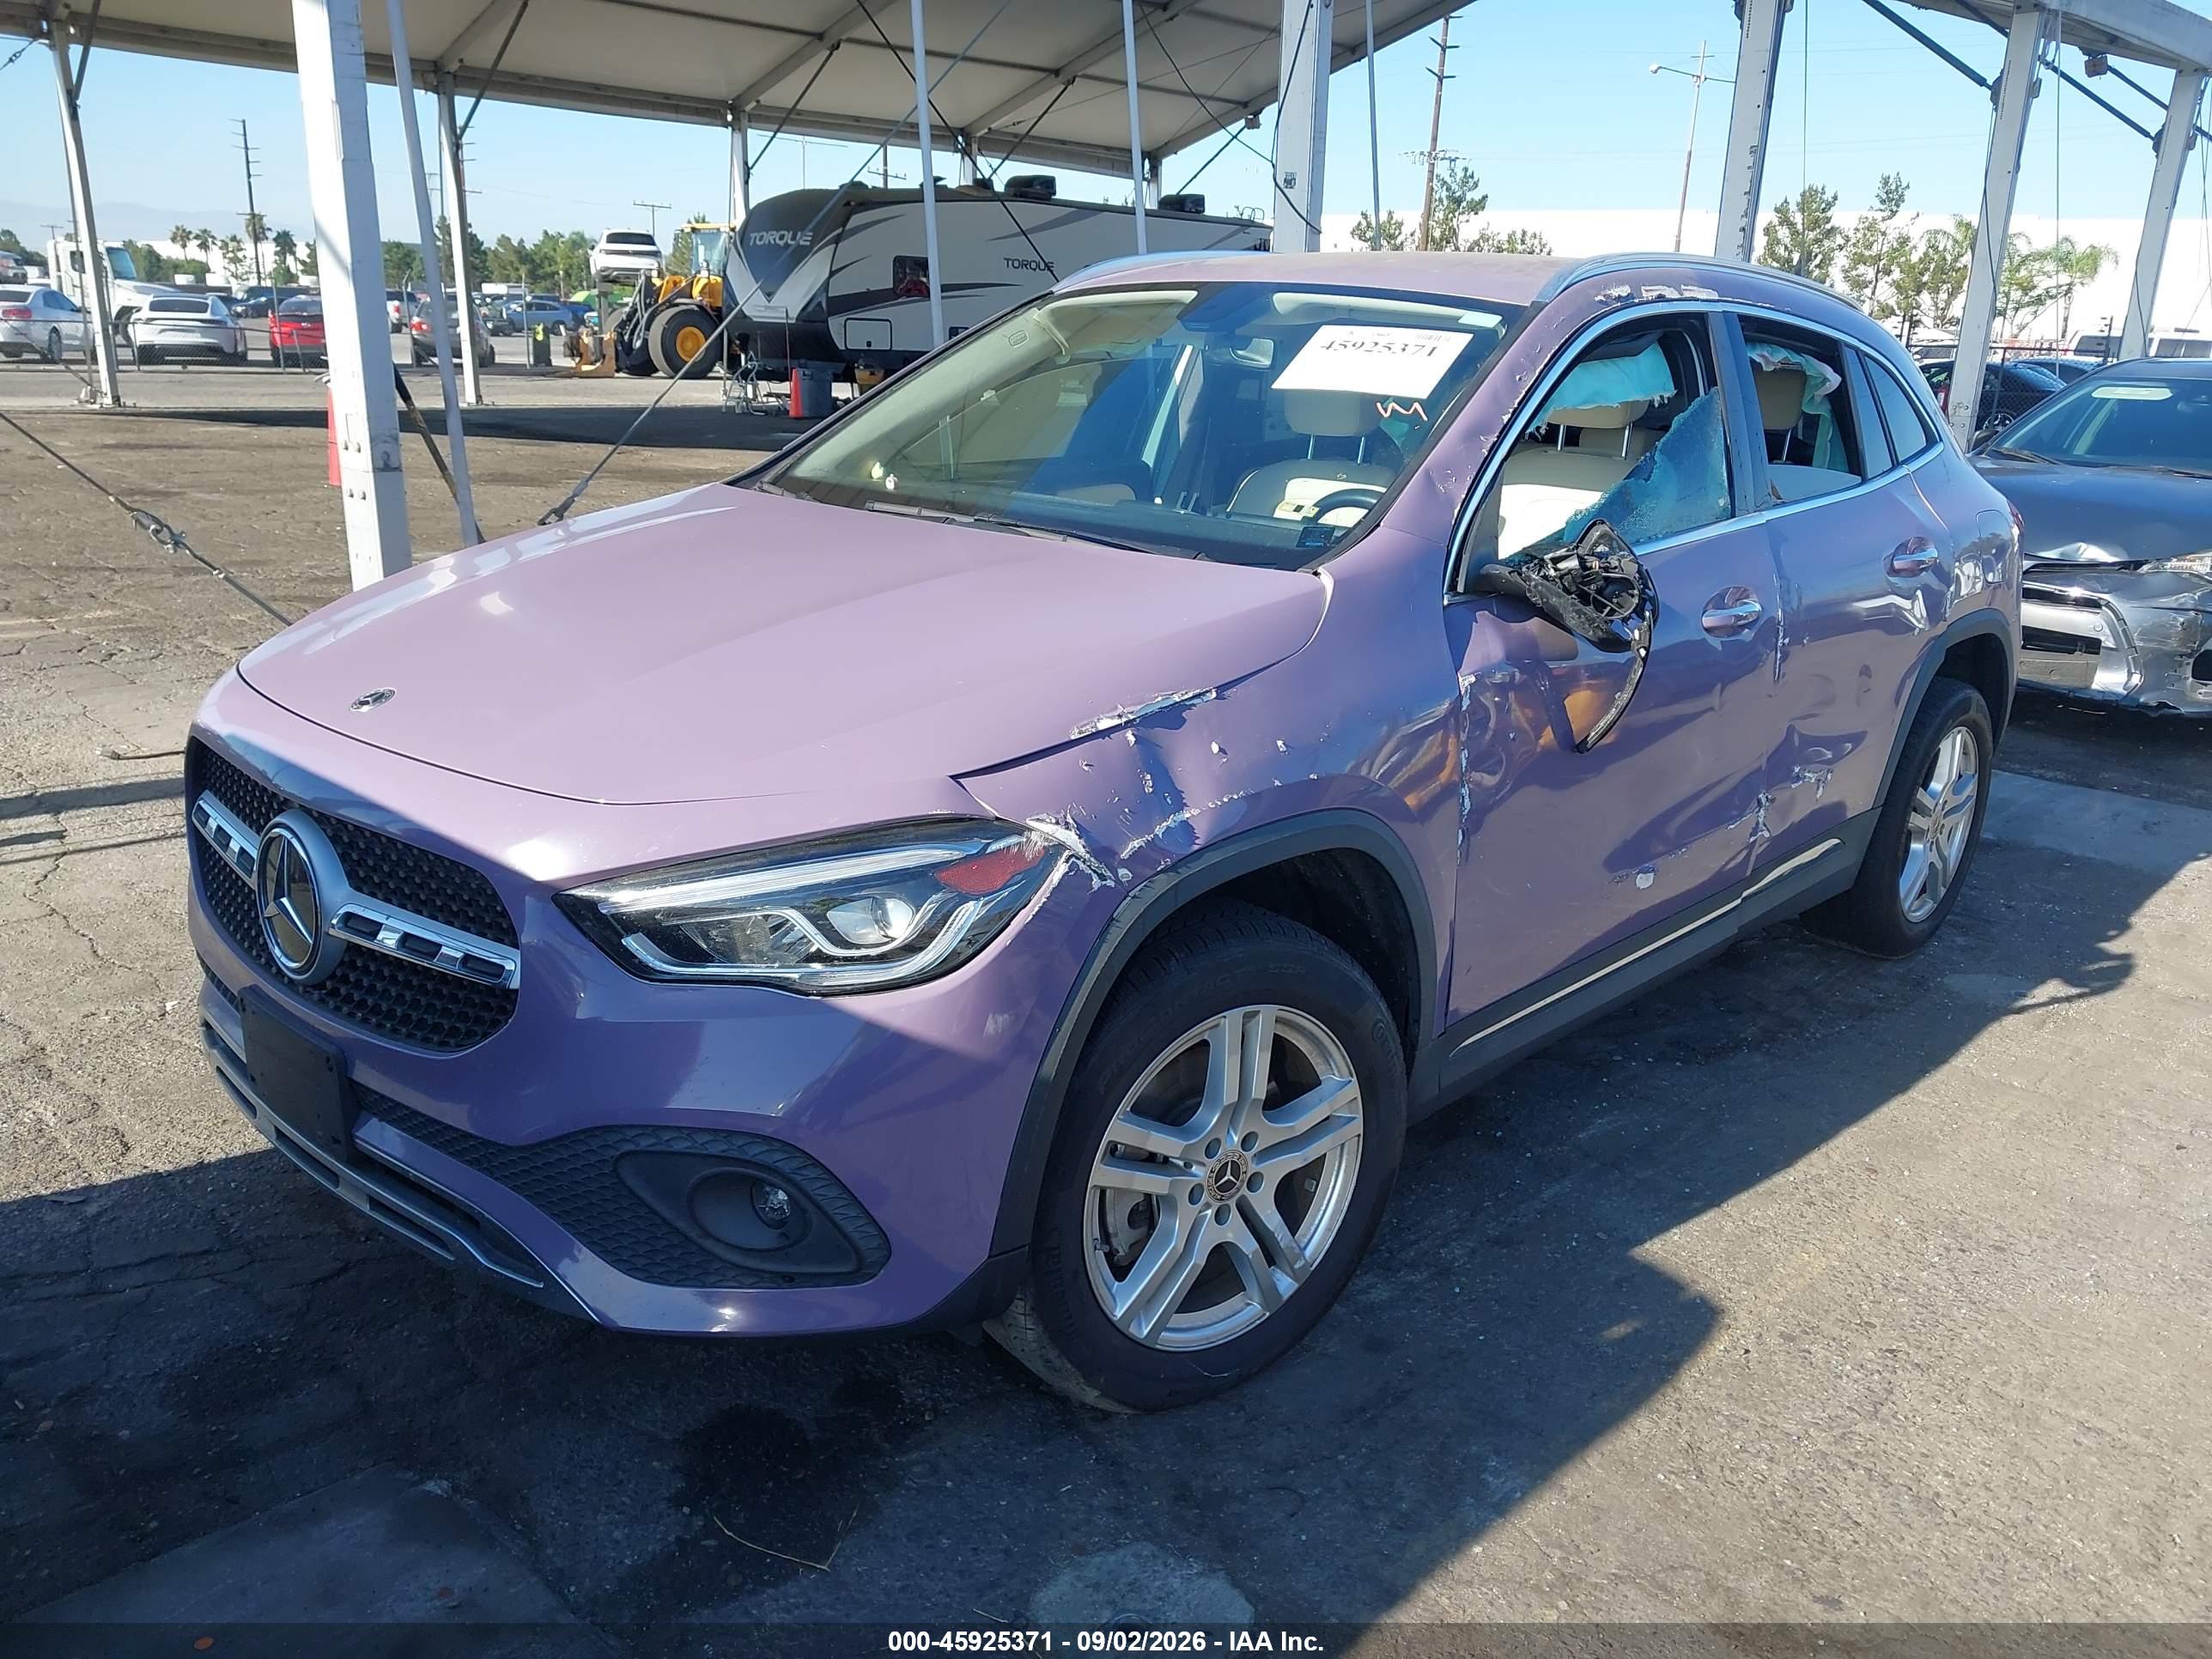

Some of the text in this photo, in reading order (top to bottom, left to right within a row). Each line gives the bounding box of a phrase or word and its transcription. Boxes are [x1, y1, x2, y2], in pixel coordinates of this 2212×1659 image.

[750, 230, 813, 246] TORQUE
[1004, 258, 1054, 272] TORQUE
[1320, 338, 1438, 357] 45925371
